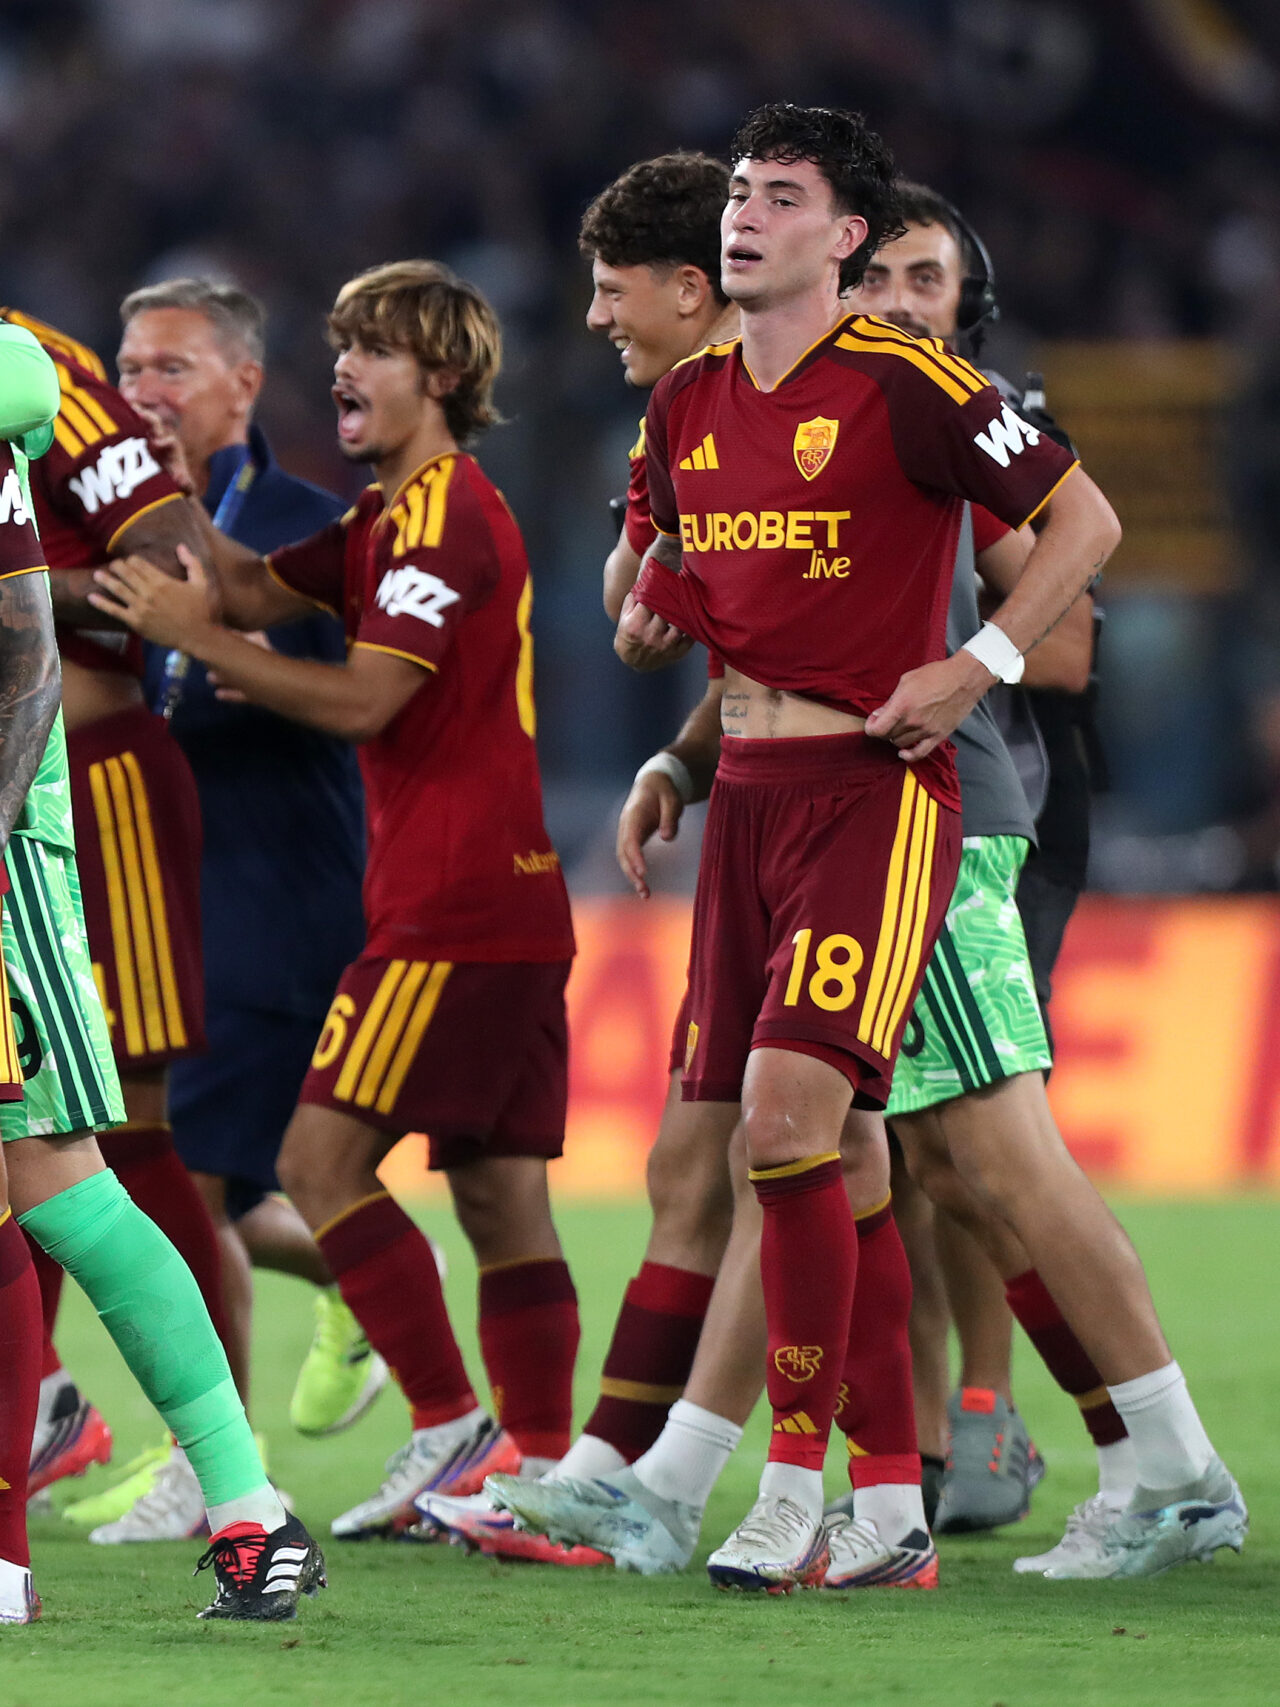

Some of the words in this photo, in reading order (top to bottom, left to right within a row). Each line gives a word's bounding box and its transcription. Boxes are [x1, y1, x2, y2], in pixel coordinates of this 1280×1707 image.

[679, 510, 851, 553] EUROBET
[802, 549, 851, 579] .live
[783, 928, 864, 1012] 18
